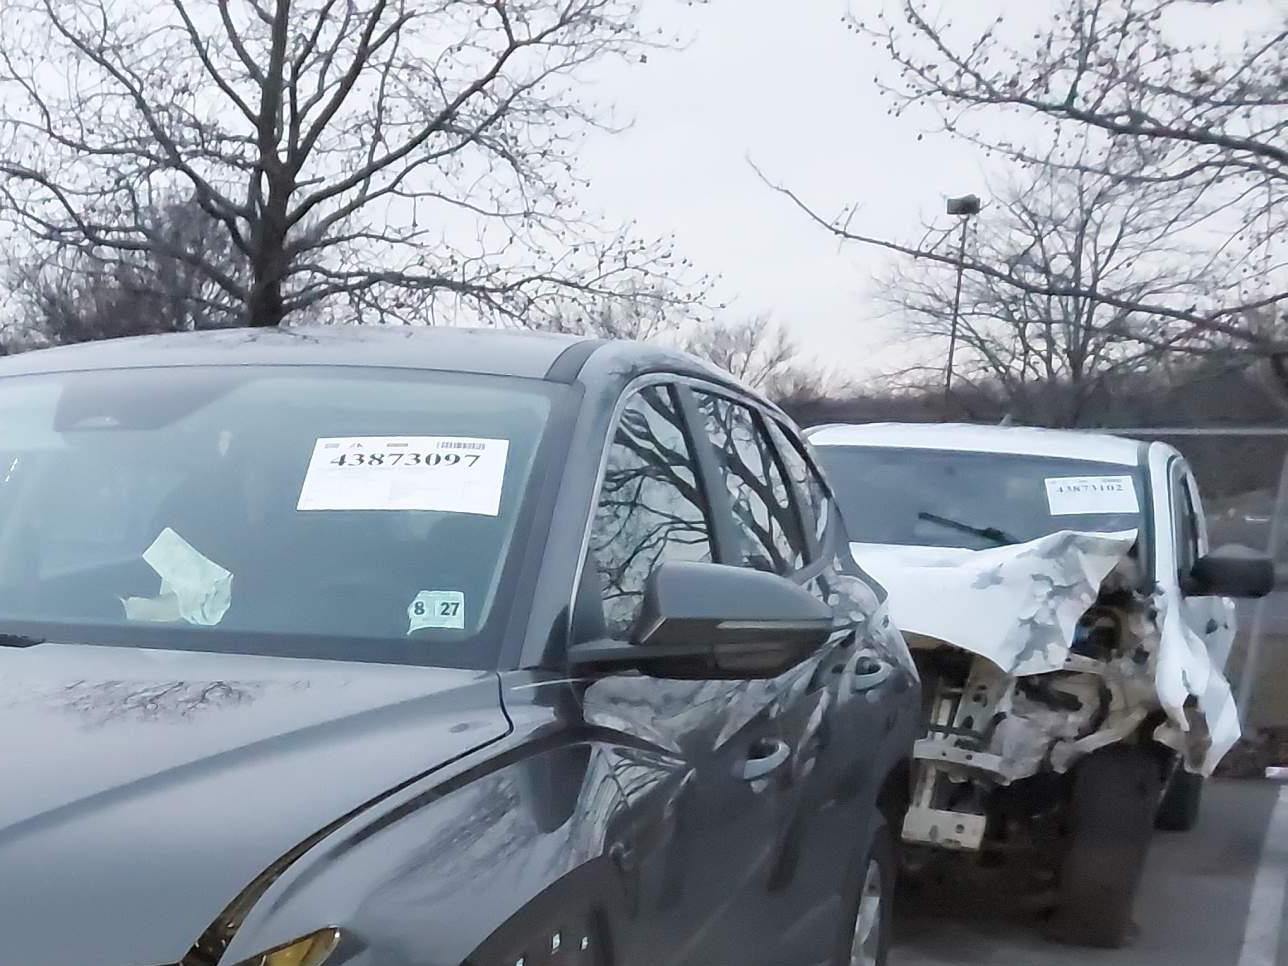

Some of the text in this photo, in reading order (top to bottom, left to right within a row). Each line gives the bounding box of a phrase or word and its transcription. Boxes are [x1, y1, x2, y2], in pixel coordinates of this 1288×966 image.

[329, 452, 482, 468] 43873097
[413, 601, 460, 617] 8 27
